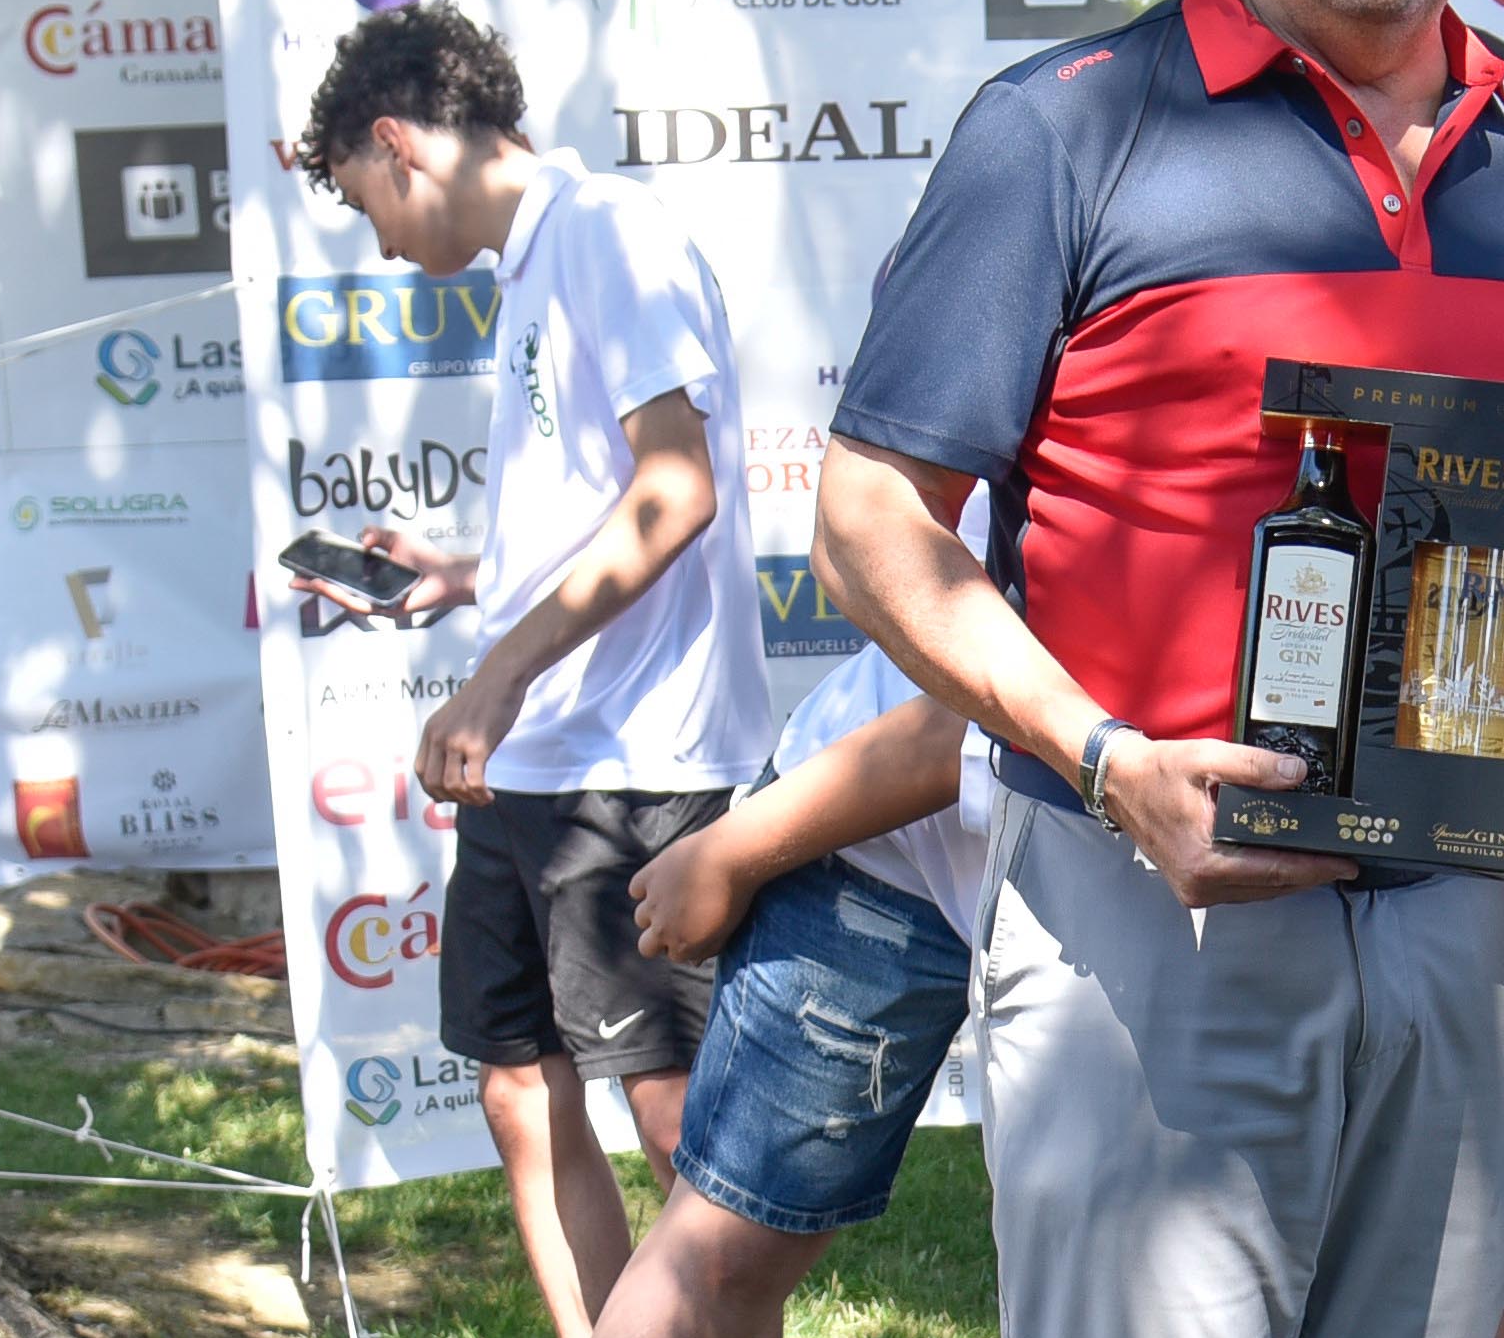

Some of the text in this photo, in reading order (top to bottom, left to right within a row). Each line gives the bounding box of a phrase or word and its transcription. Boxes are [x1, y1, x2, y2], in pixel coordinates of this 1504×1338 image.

[1072, 49, 1115, 71] PING
[613, 99, 933, 168] IDEAL
[1353, 387, 1478, 412] PREMIUM
[49, 493, 189, 513] SOLUGRA
[1265, 593, 1346, 627] RIVES
[767, 638, 847, 656] VENTUCELI
[1278, 649, 1322, 667] GIN
[119, 807, 221, 838] BLISS
[1232, 812, 1249, 825] 14
[1279, 817, 1299, 831] 92
